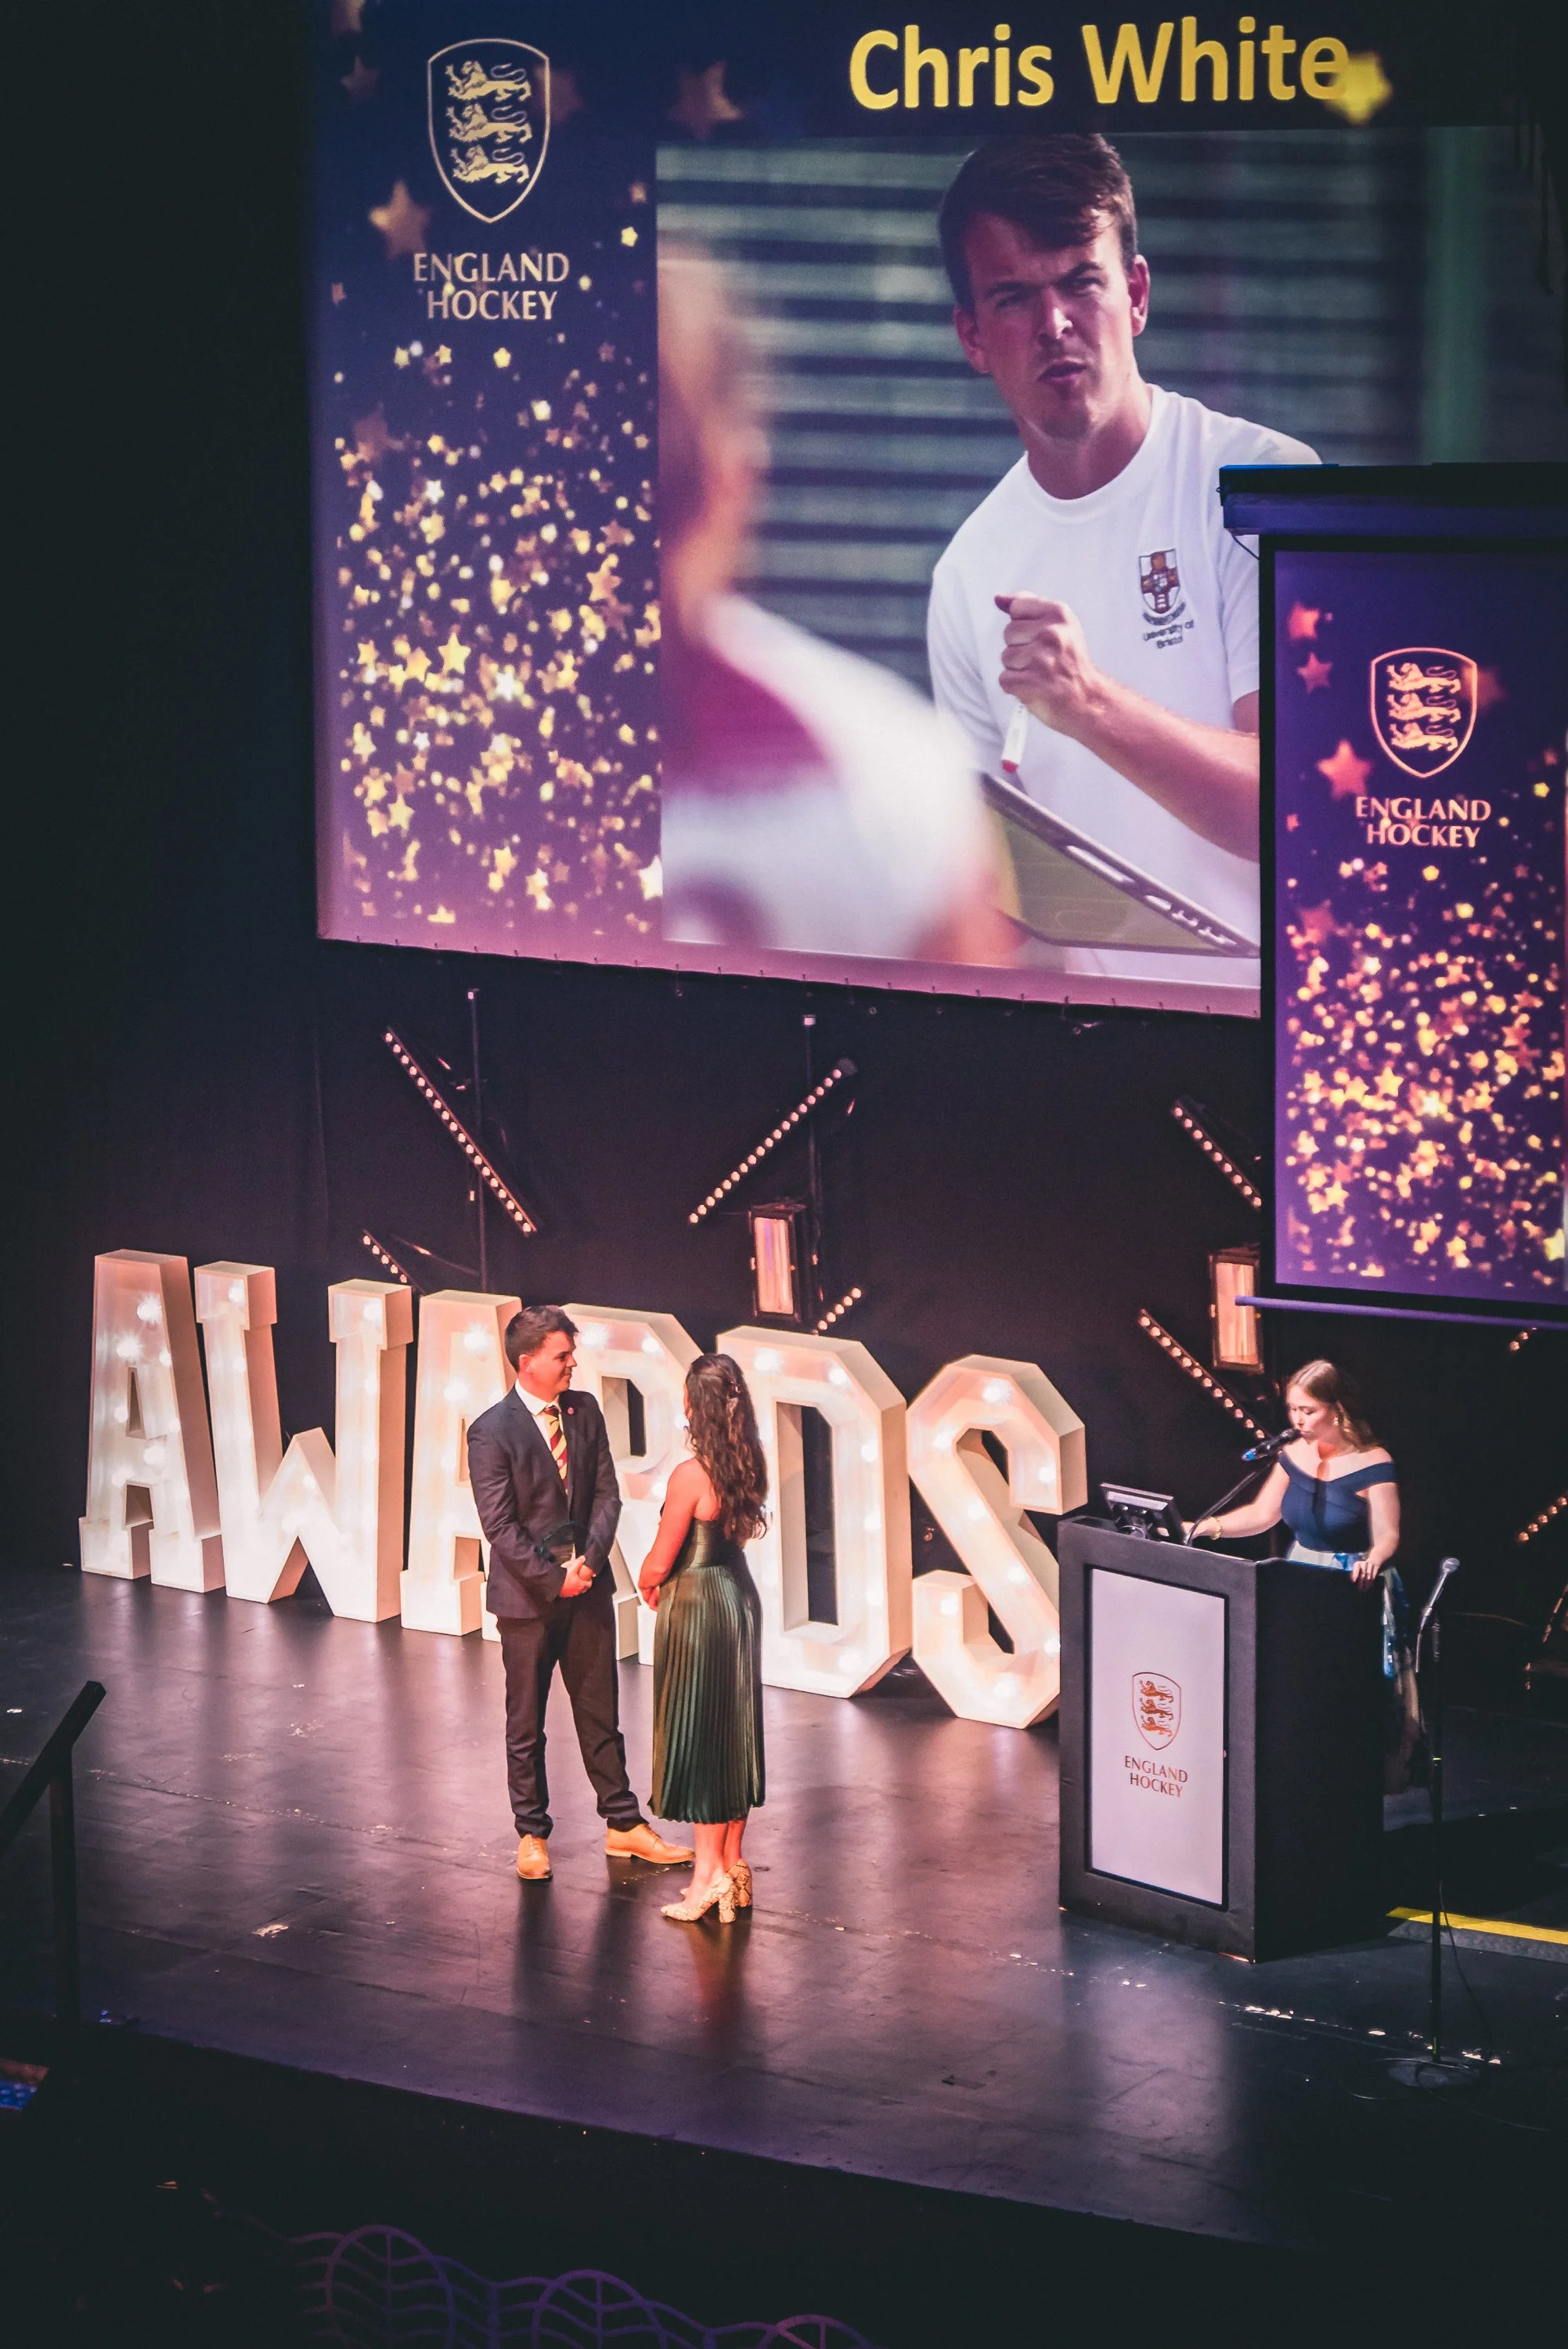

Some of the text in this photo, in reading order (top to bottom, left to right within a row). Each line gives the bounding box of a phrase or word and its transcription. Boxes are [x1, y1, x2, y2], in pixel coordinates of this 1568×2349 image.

[850, 16, 1349, 109] Chris White
[413, 252, 570, 283] ENGLAND
[427, 290, 557, 320] HOCKEY
[1355, 796, 1491, 821] ENGLAND
[1367, 824, 1480, 848] HOCKEY
[79, 1250, 1087, 1729] AWARDS
[1124, 1755, 1188, 1783] ENGLAND
[1130, 1772, 1184, 1798] HOCKEY
